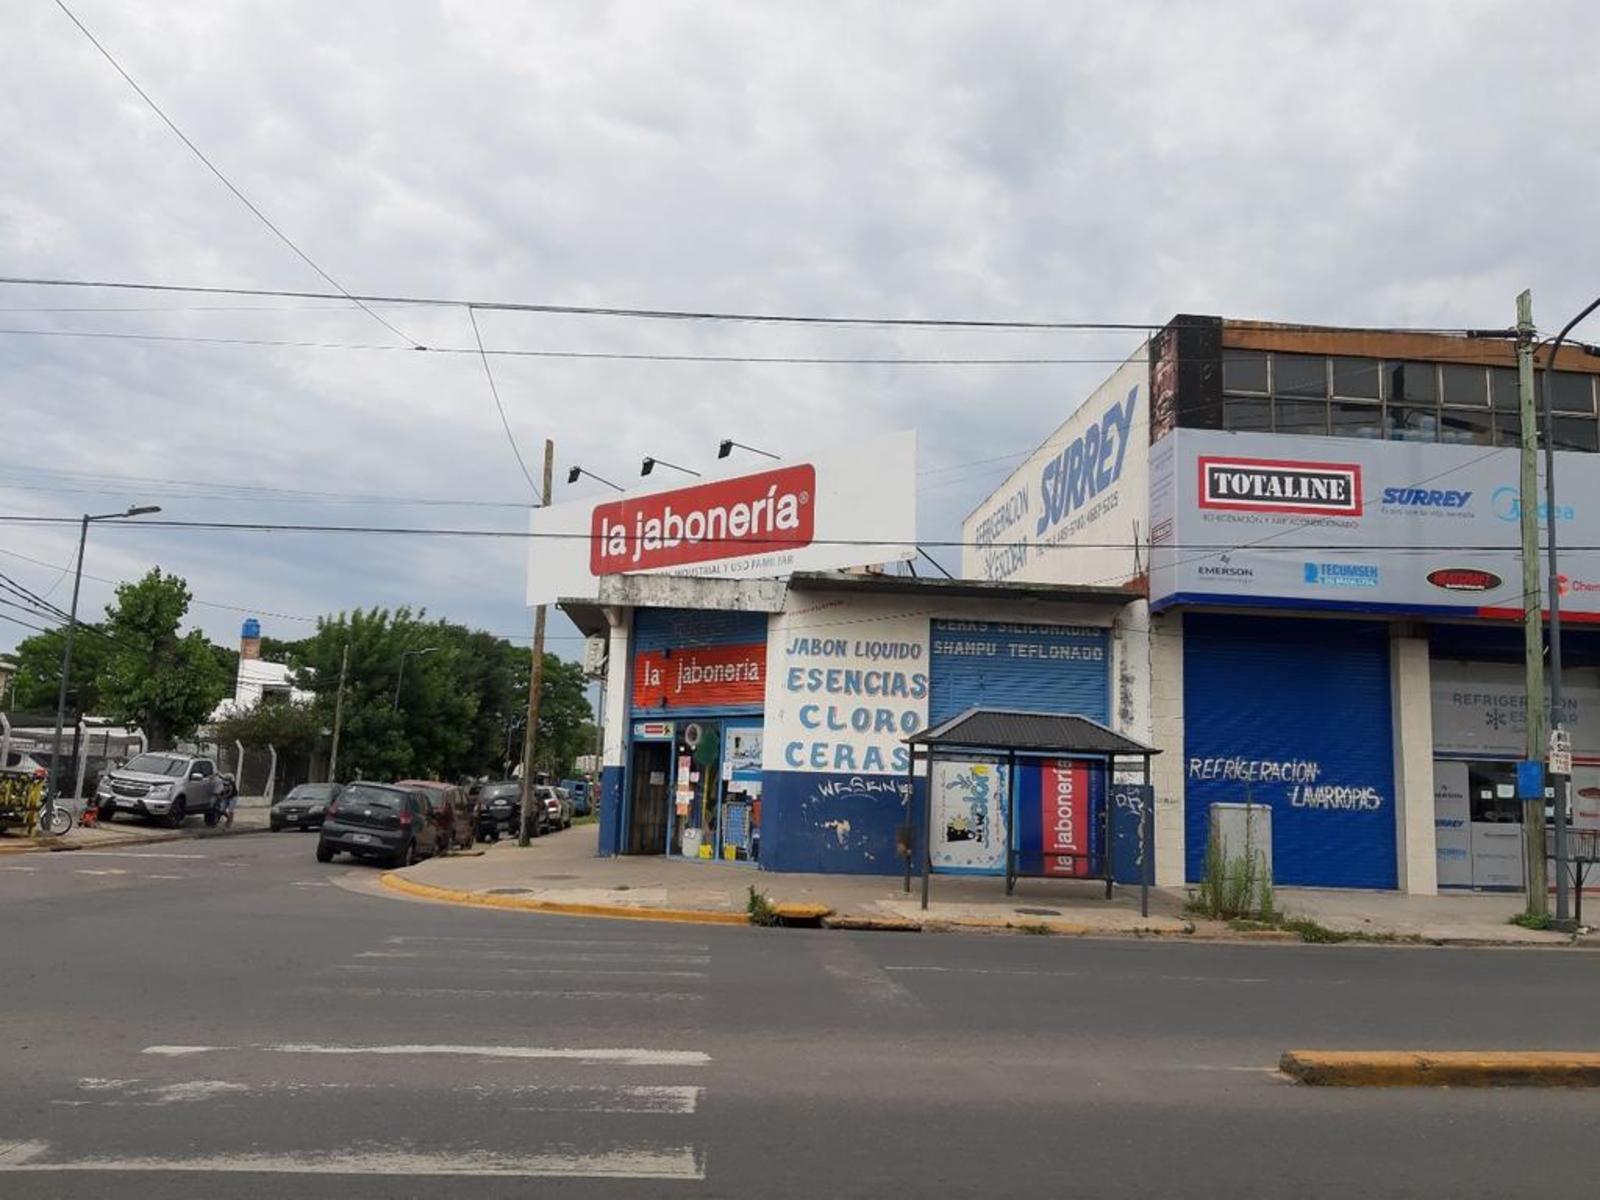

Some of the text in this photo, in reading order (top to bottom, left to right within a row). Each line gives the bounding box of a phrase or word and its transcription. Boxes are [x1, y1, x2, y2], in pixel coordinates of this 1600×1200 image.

[1036, 384, 1139, 537] SURREY
[1214, 473, 1345, 500] TOTALINE
[1382, 487, 1472, 507] SURREY
[601, 485, 799, 562] la jabonería
[1198, 566, 1253, 577] EMERSON
[1321, 563, 1377, 578] TECUMSEH
[786, 638, 922, 661] JABON LIQUIDO
[933, 640, 1104, 661] SHAMPU TEFLONADO
[644, 661, 662, 686] la
[786, 667, 928, 699] ESENCIAS
[799, 704, 920, 734] CLORO
[784, 741, 910, 771] CERAS
[1053, 856, 1073, 872] la
